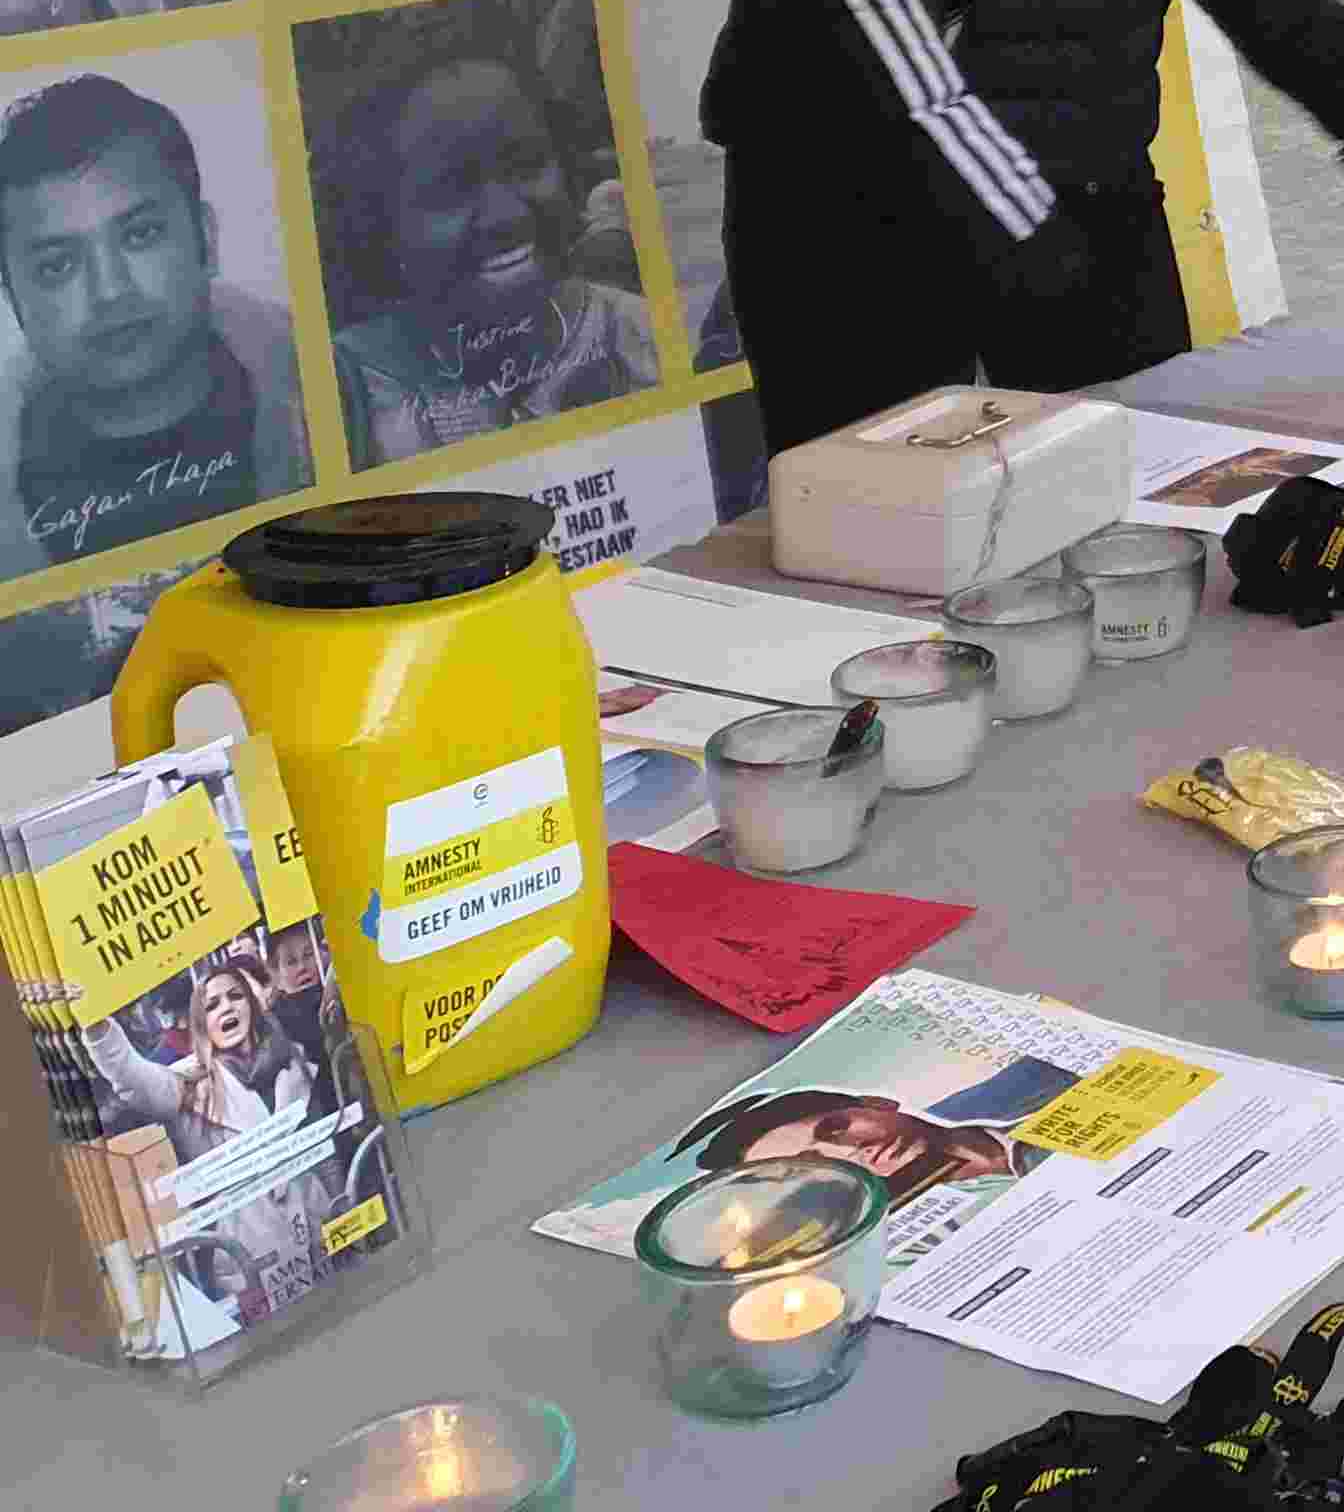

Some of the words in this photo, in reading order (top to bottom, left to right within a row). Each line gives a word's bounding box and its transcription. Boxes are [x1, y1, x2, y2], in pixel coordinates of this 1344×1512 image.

[541, 484, 572, 507] ER
[573, 467, 615, 503] NIET
[565, 506, 604, 539] HAD
[609, 496, 629, 525] IK
[92, 834, 159, 891] KOM
[404, 837, 481, 881] AMNESTY
[404, 859, 483, 897] INTERNATIONAL
[70, 913, 97, 946] 1
[97, 846, 205, 931] MINUUT
[407, 907, 455, 940] GEEF
[459, 895, 485, 921] OM
[490, 866, 561, 908] VRIJHEID
[97, 933, 135, 973] IN
[136, 886, 212, 953] ACTIE
[424, 985, 475, 1020] VOOR
[1026, 1103, 1080, 1136] WRITE
[1047, 1120, 1082, 1143] FOR
[1063, 1111, 1121, 1148] RIGHTS
